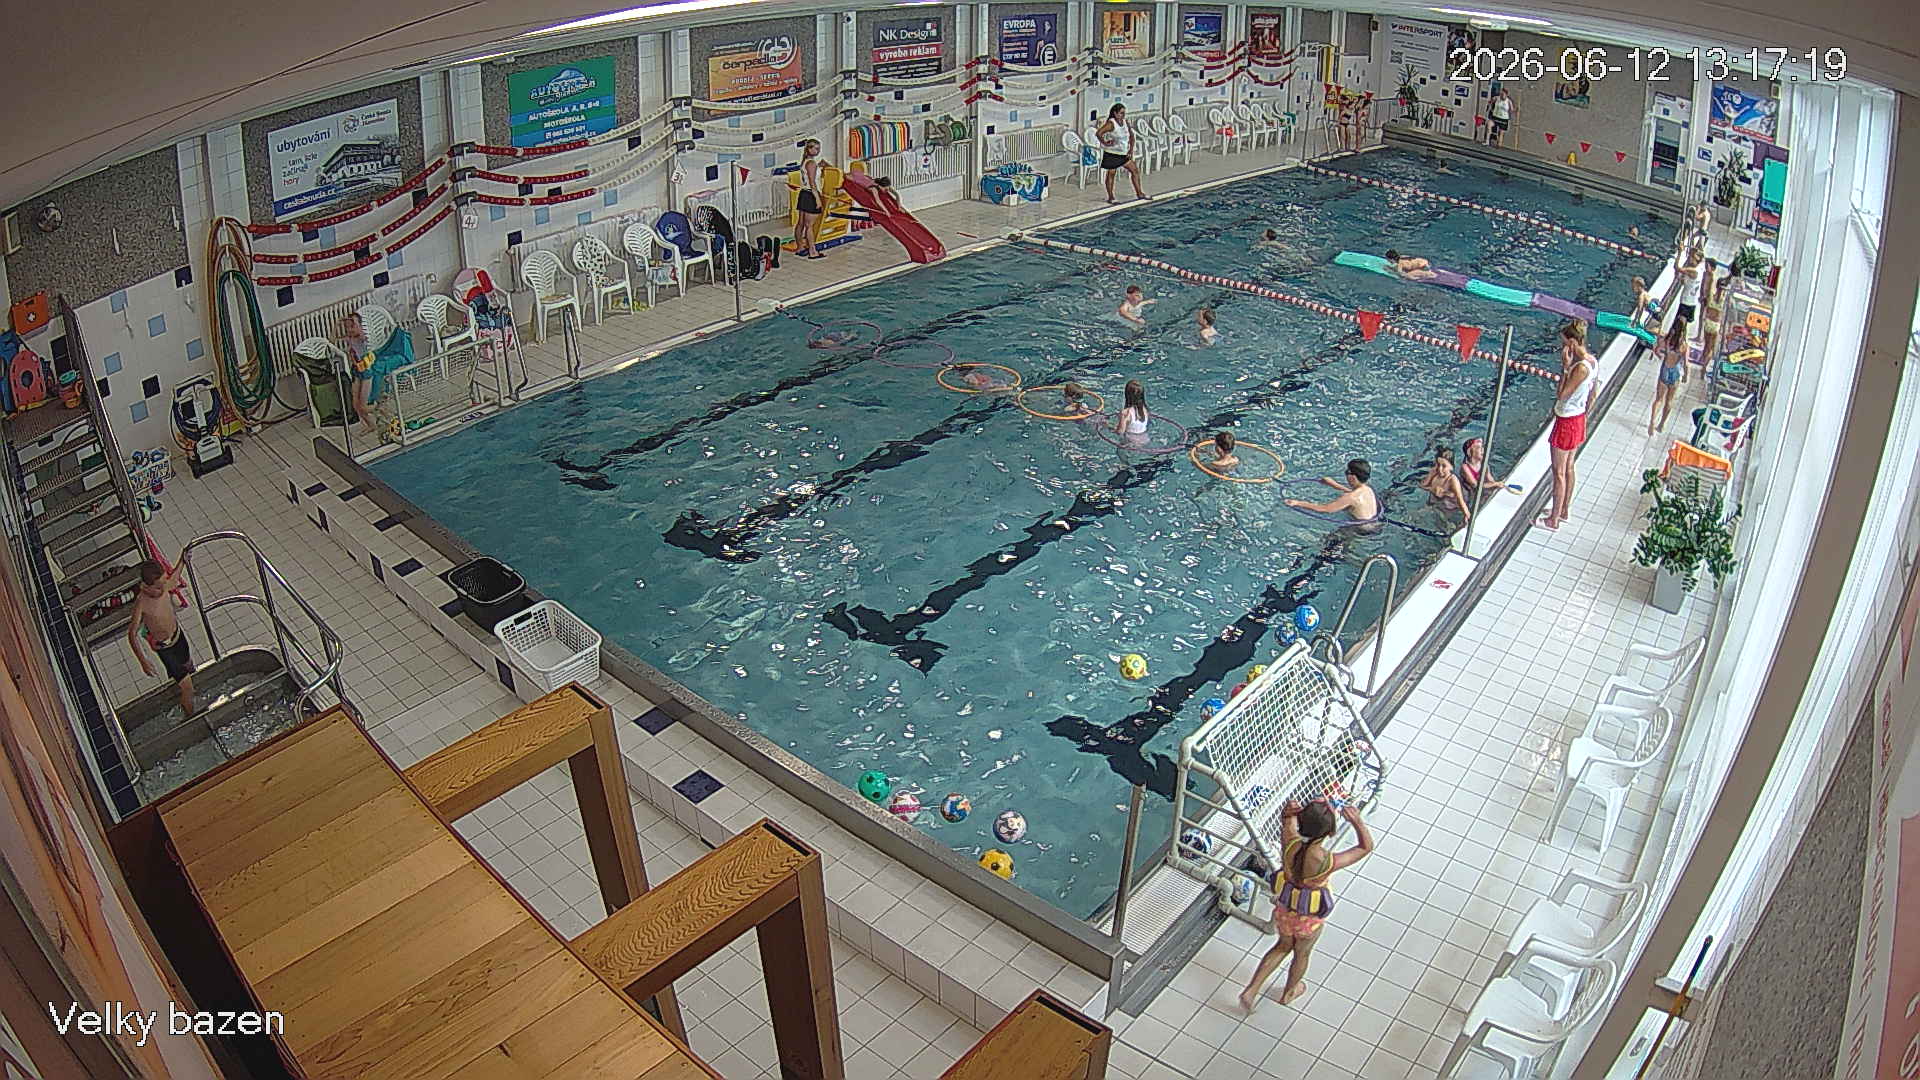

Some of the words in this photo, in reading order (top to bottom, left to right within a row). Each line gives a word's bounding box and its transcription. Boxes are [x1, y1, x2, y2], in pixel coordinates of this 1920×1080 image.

[1003, 19, 1036, 29] EVROPA
[880, 28, 897, 41] NK
[900, 28, 928, 40] Design
[910, 46, 937, 57] reklam
[276, 127, 331, 153] ubytování
